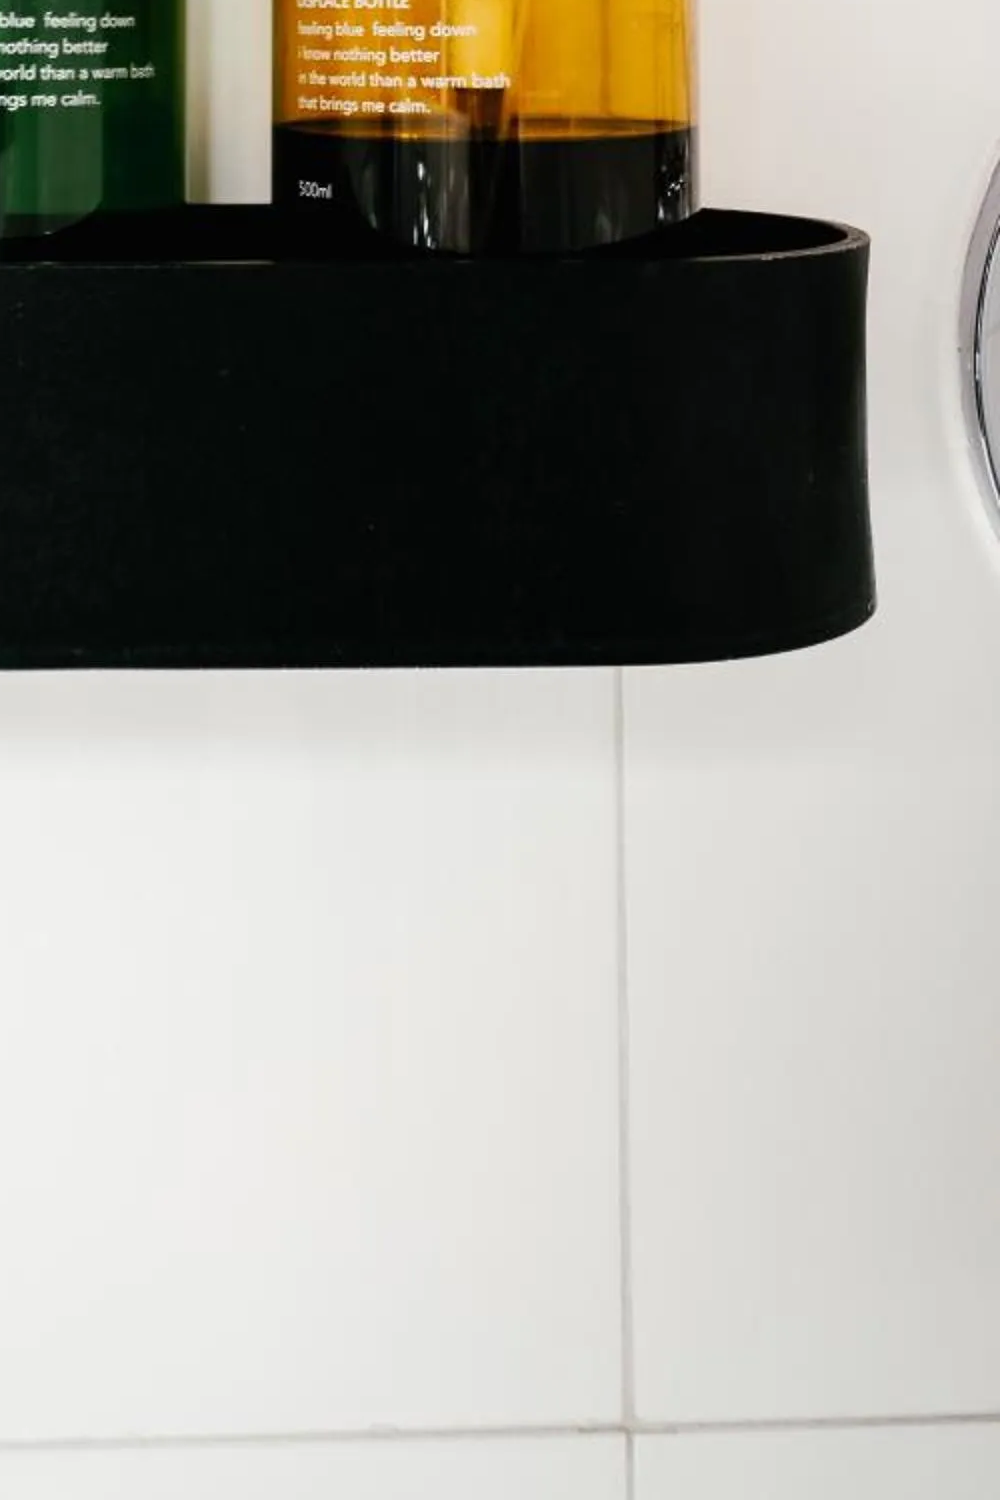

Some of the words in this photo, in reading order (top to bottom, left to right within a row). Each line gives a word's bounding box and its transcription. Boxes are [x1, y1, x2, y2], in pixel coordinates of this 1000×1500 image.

[43, 11, 96, 33] feeling
[100, 12, 136, 28] down
[335, 20, 364, 37] blue
[372, 20, 425, 40] feeling
[430, 20, 478, 38] down
[62, 37, 108, 54] better
[333, 46, 386, 66] nothing
[389, 46, 440, 63] better
[39, 63, 75, 80] than
[79, 67, 88, 80] a
[91, 66, 128, 79] warm
[309, 70, 326, 85] the
[328, 70, 365, 87] world
[369, 72, 403, 88] than
[407, 76, 416, 89] a
[421, 75, 467, 89] warm
[470, 71, 511, 90] bath
[30, 94, 56, 107] me
[60, 90, 101, 107] calm.
[319, 95, 358, 115] brings
[362, 100, 385, 113] me
[389, 97, 432, 114] calm.
